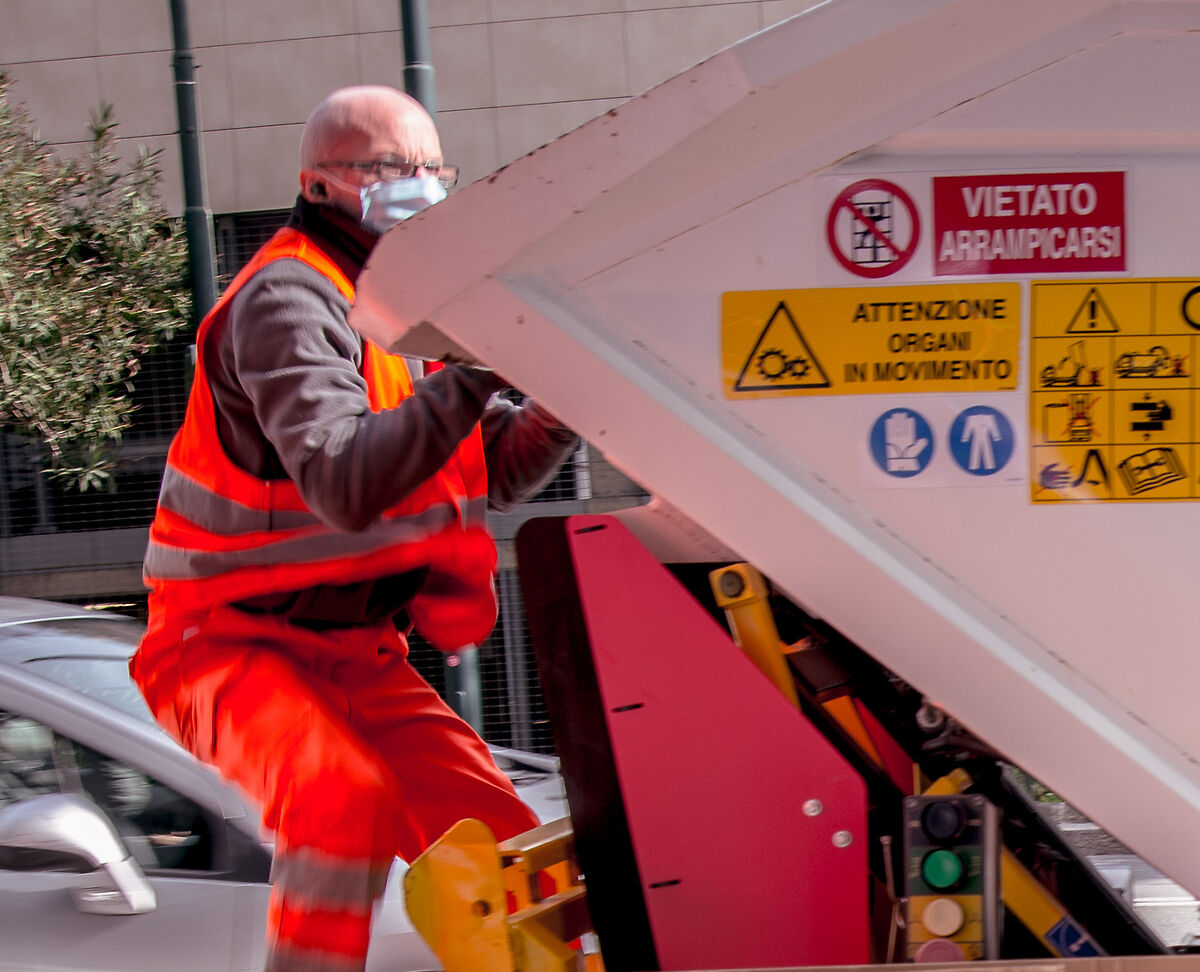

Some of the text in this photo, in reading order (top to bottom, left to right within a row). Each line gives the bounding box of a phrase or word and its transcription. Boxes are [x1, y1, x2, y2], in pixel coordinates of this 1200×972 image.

[961, 183, 1098, 218] VIETATO
[939, 226, 1122, 262] ARRAMPICARSI
[852, 299, 1008, 323] ATTENZIONE
[888, 332, 972, 353] ORGANI
[844, 359, 1012, 383] IN MOVIMENTO
